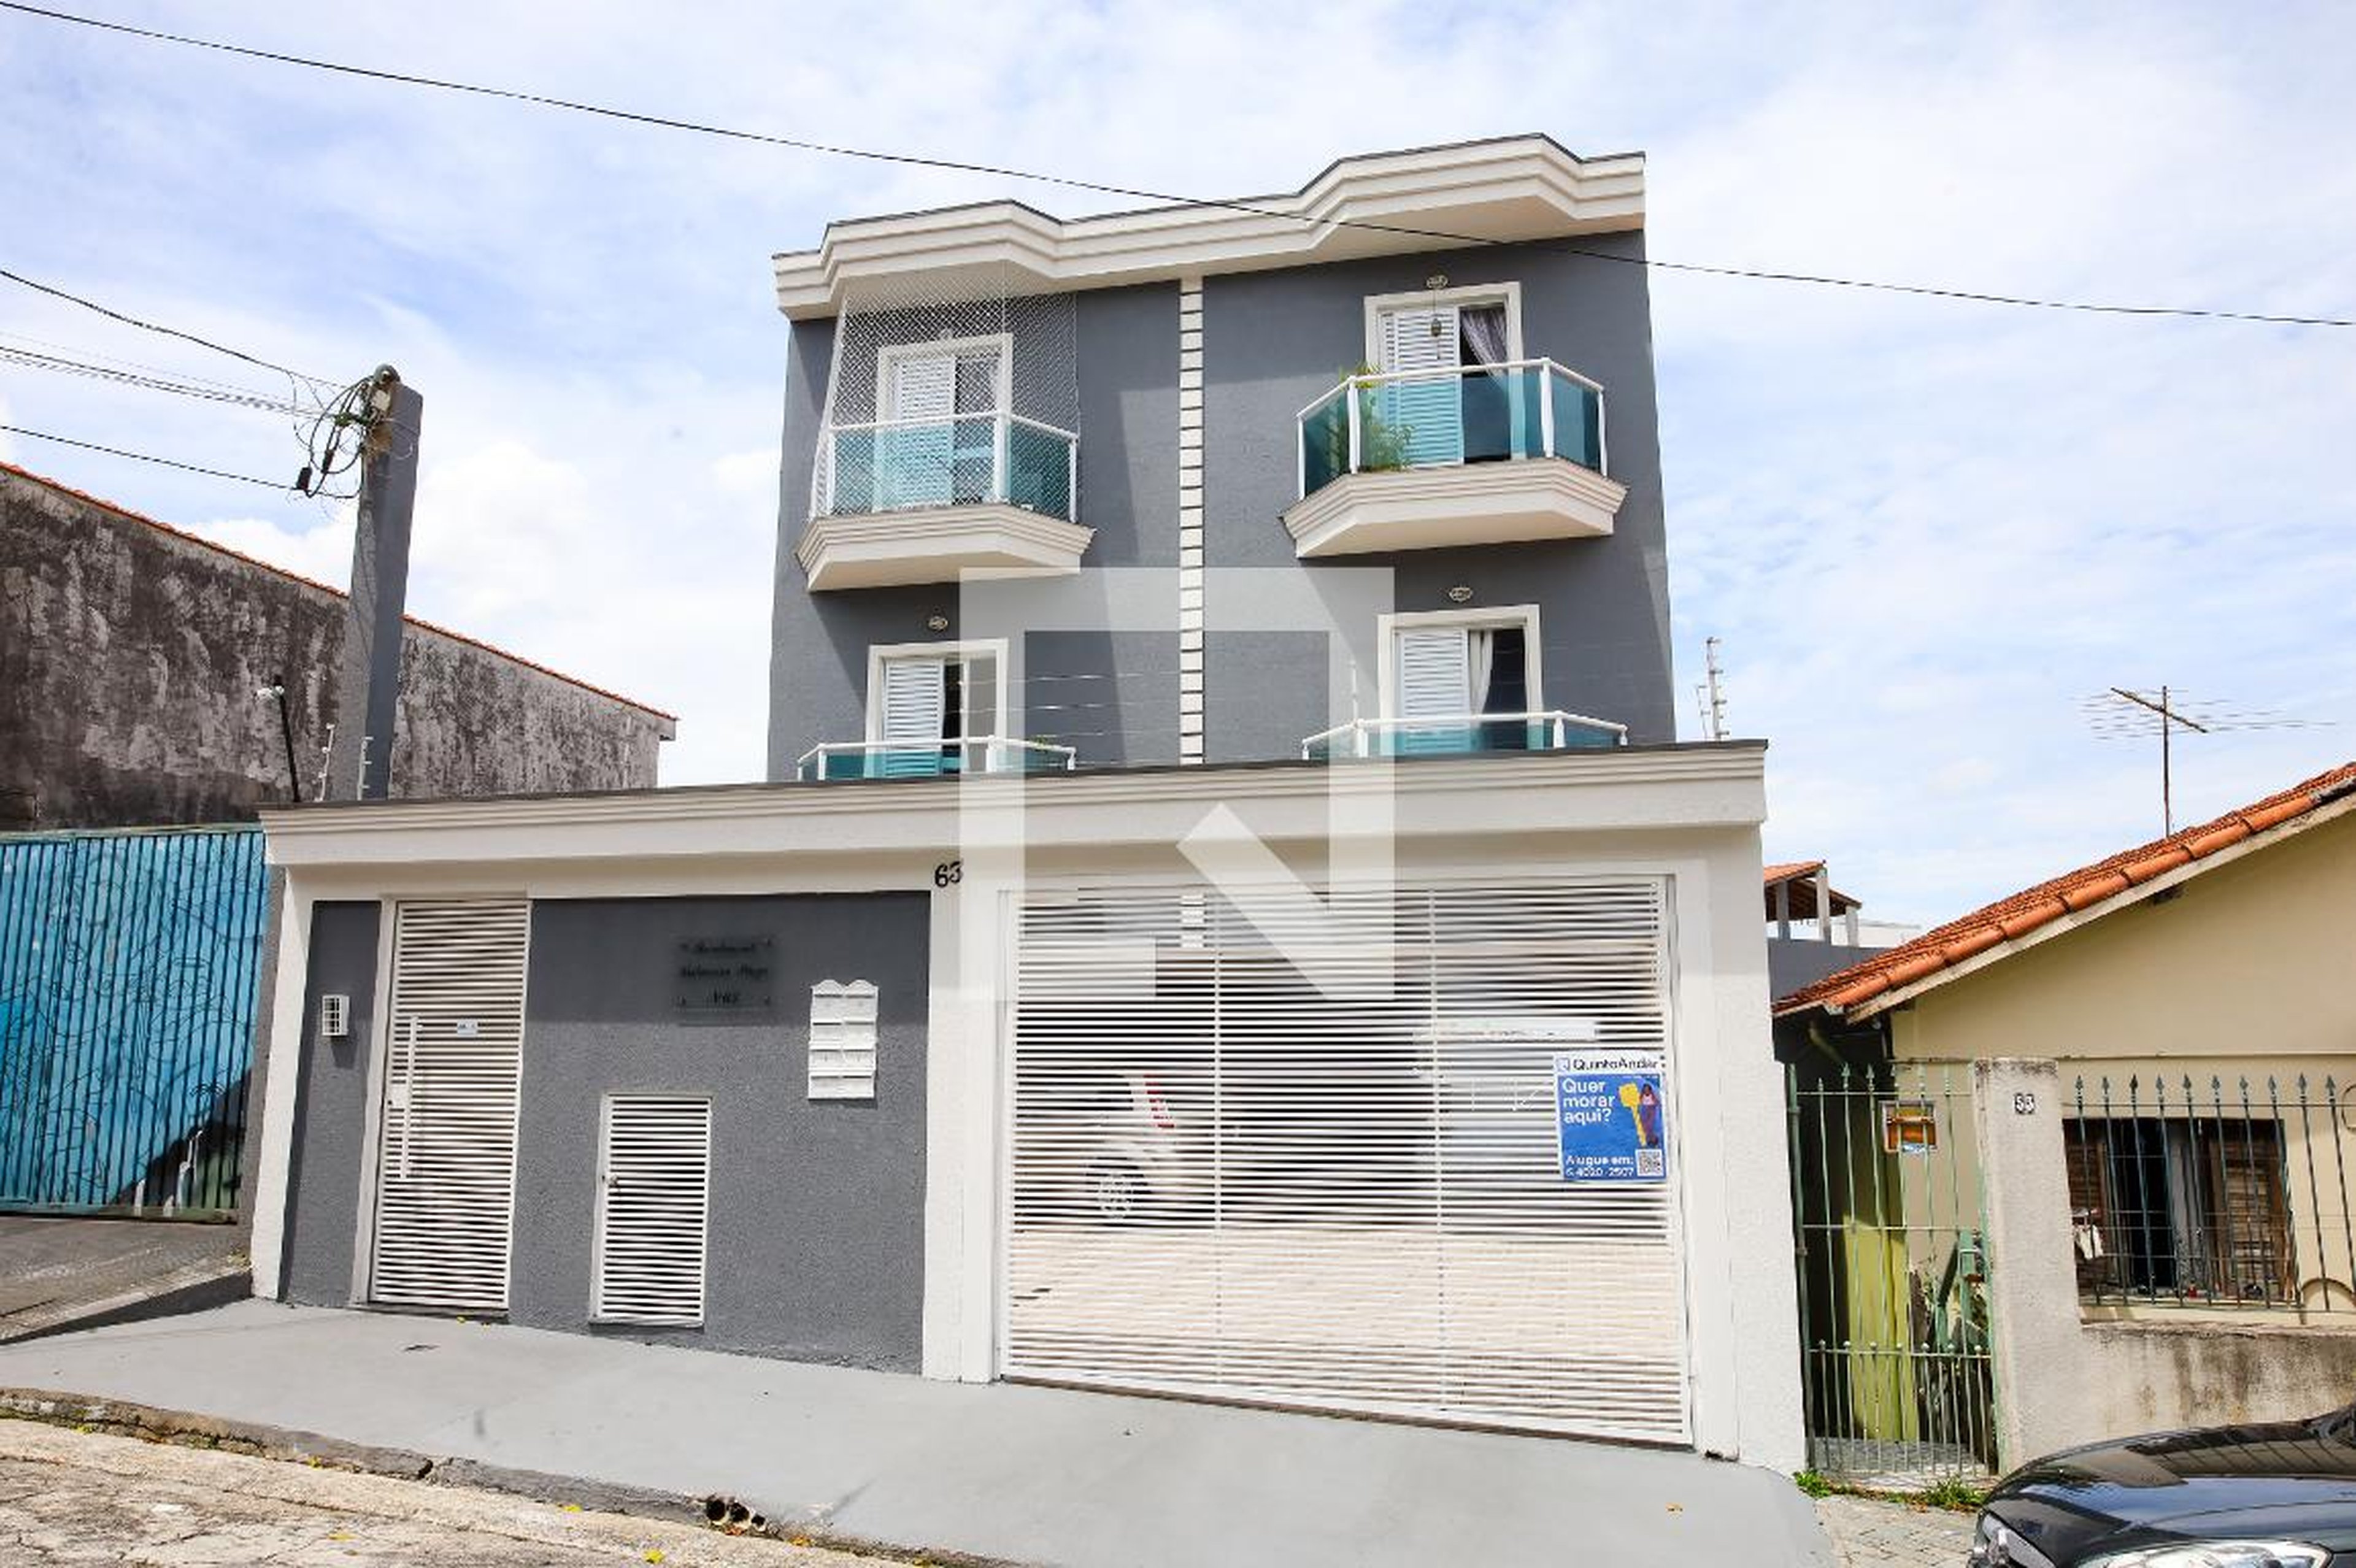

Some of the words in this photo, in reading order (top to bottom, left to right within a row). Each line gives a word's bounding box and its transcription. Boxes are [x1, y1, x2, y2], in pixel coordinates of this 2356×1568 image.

[934, 861, 961, 888] 63
[1563, 1078, 1606, 1093] Quer
[1564, 1096, 1615, 1107] morar
[1565, 1109, 1612, 1125] aqui?
